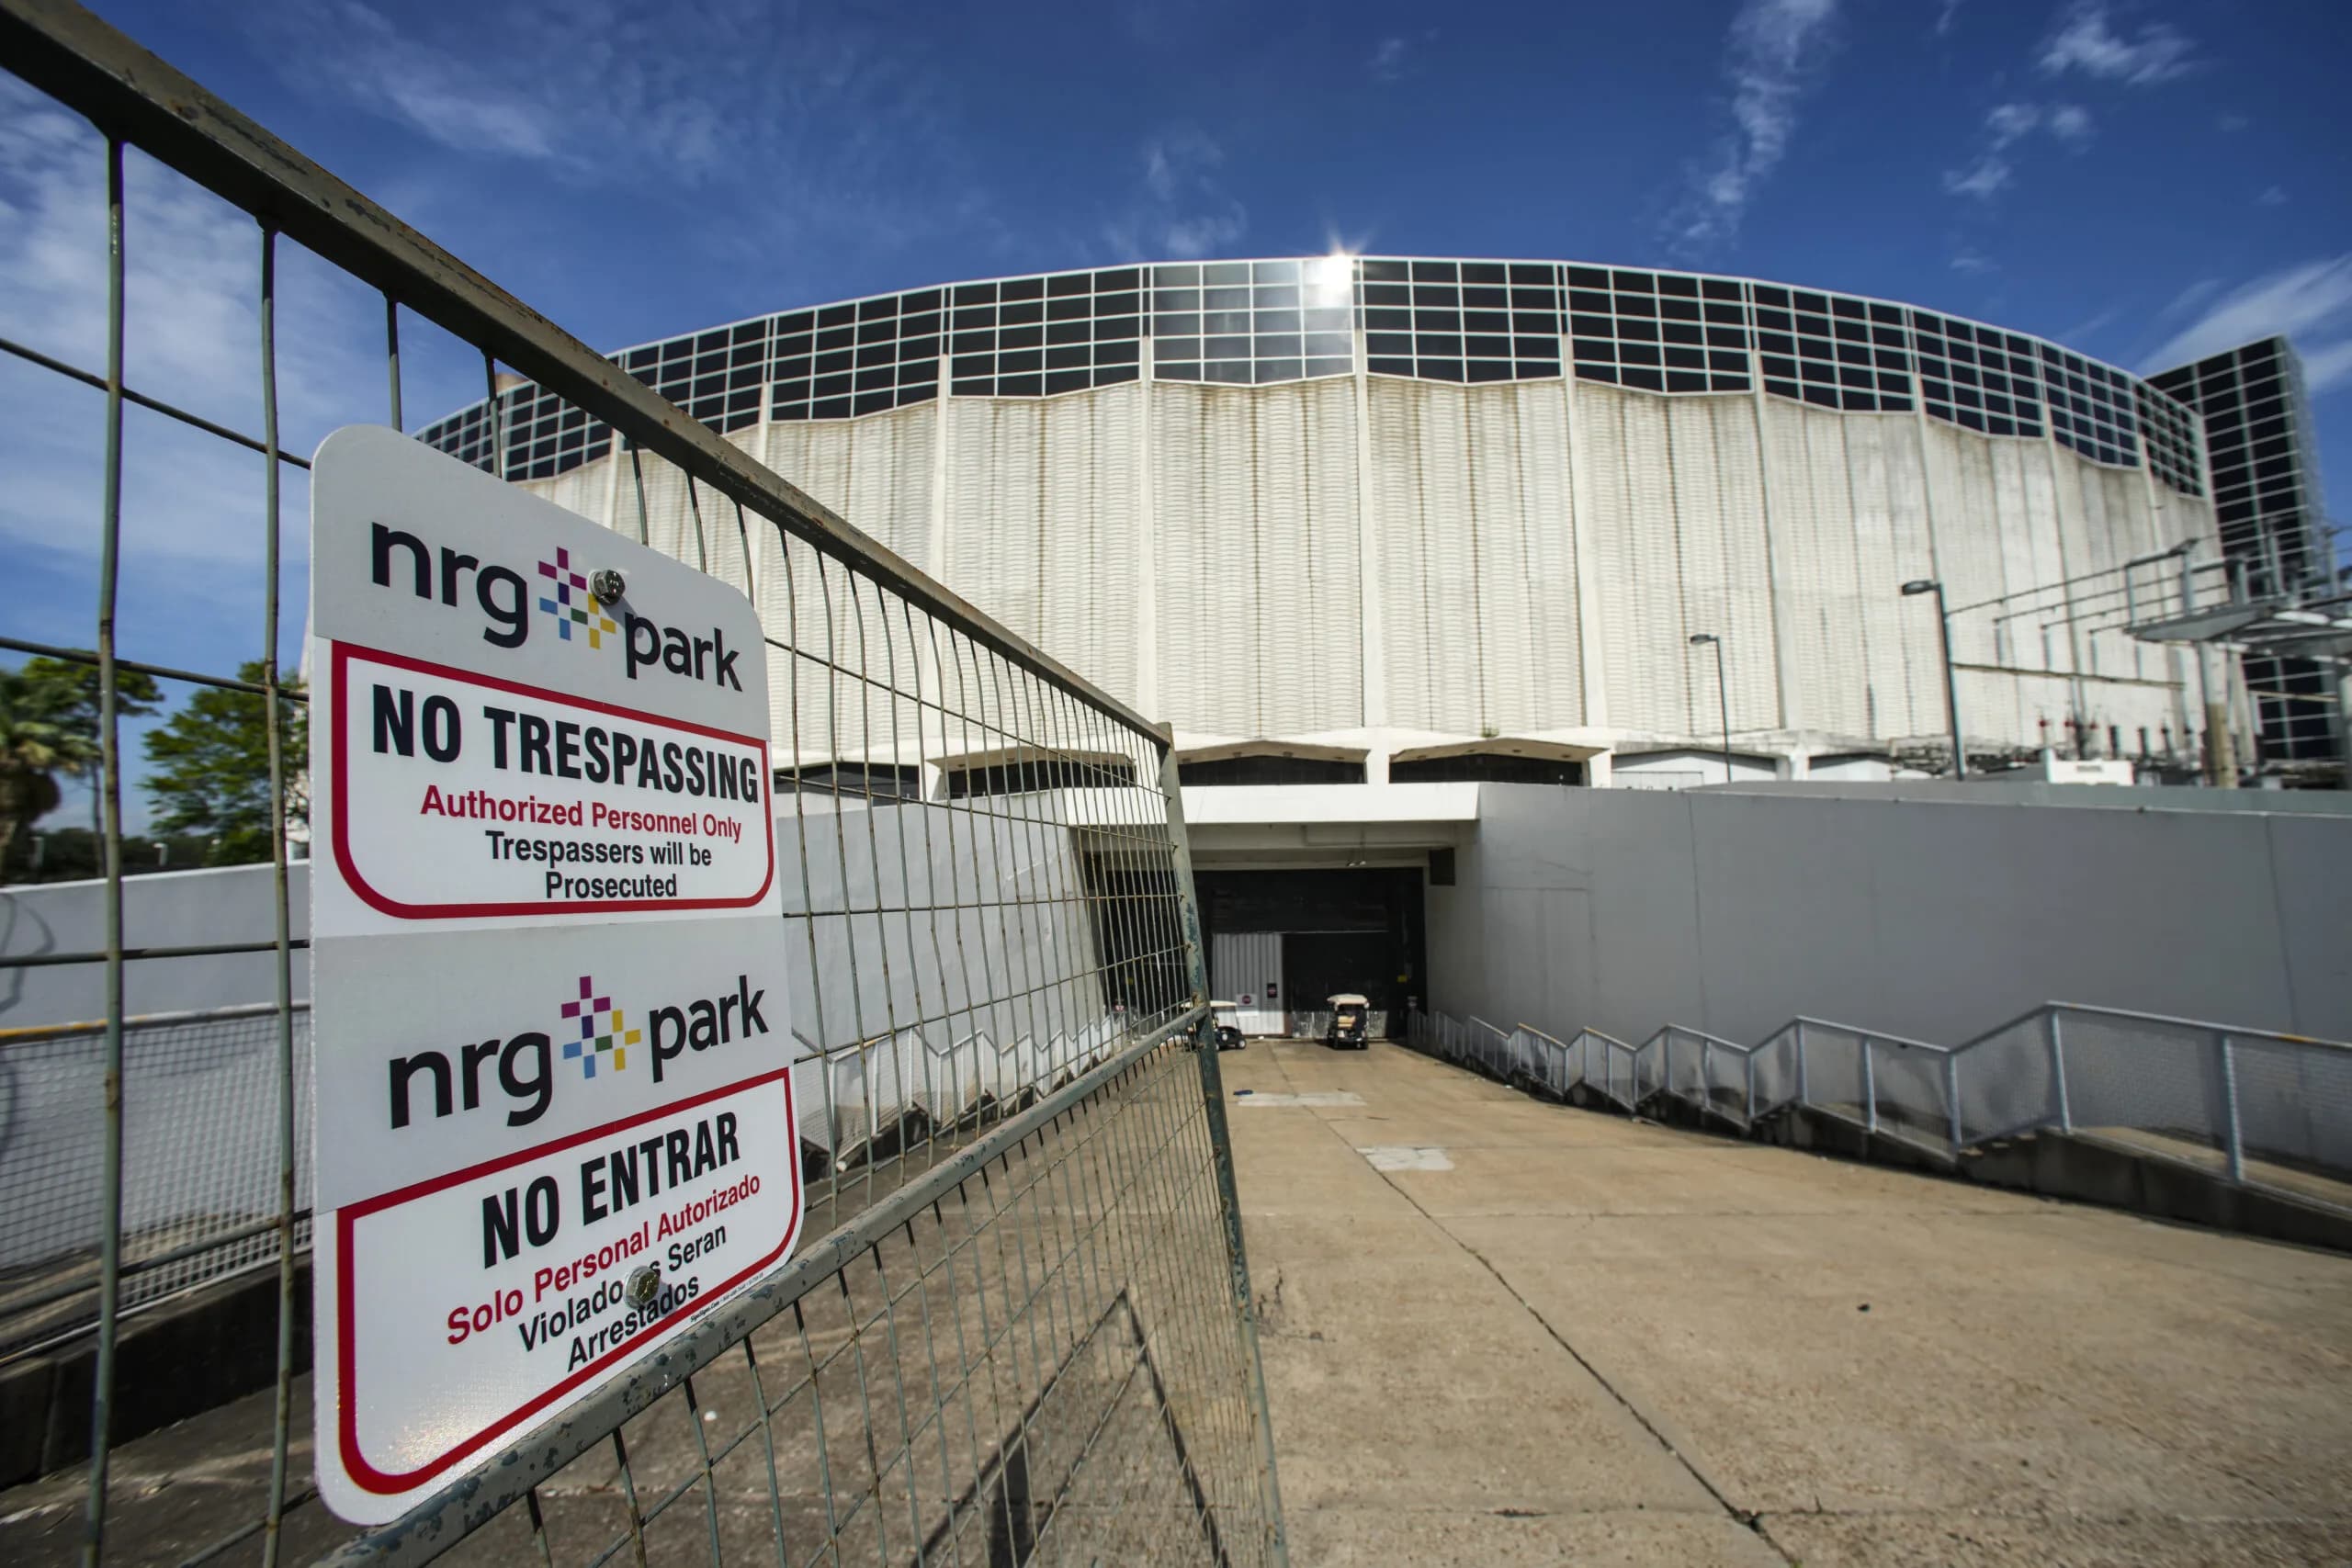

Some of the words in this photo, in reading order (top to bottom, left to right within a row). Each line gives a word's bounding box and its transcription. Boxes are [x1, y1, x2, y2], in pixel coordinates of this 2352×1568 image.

[371, 521, 528, 649] nrg
[624, 610, 743, 693] park
[372, 683, 461, 763] NO
[483, 705, 759, 804] TRESPASSING
[420, 784, 583, 827] Authorized
[592, 801, 698, 837] Personnel
[703, 813, 741, 844] Only
[485, 829, 644, 868] Trespassers
[650, 841, 684, 866] will
[689, 841, 712, 867] be
[545, 870, 677, 899] Prosecuted
[389, 1032, 553, 1131] nrg
[649, 974, 770, 1083] park
[482, 1175, 560, 1269] NO
[582, 1111, 741, 1227] ENTRAR
[447, 1286, 523, 1346] Solo
[534, 1227, 650, 1305] Personal
[657, 1174, 761, 1243] Autorizado
[518, 1259, 662, 1352] Violados
[668, 1224, 727, 1272] Seran
[567, 1276, 699, 1373] Arrestados
